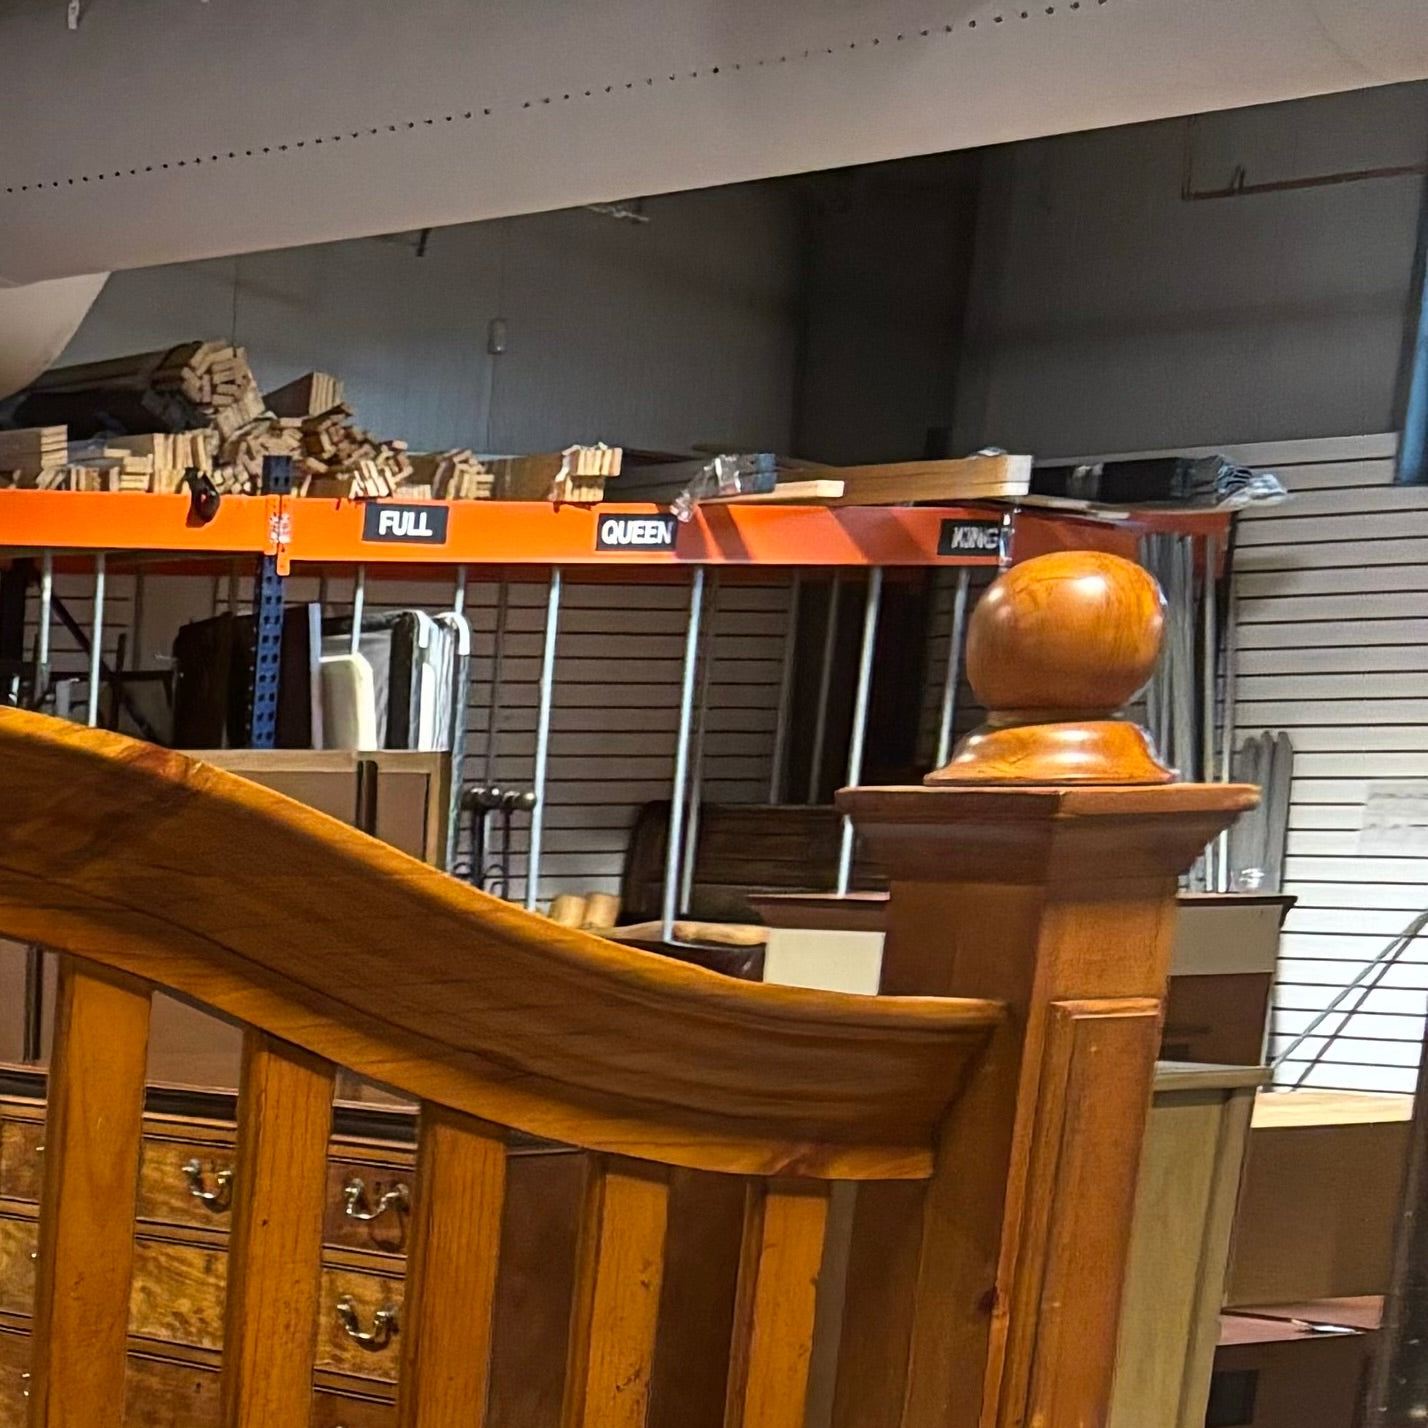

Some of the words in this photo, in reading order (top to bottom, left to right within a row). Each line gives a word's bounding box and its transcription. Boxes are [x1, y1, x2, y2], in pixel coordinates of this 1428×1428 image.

[378, 510, 433, 536] FULL
[601, 520, 672, 545] QUEEN
[951, 526, 999, 549] KING
